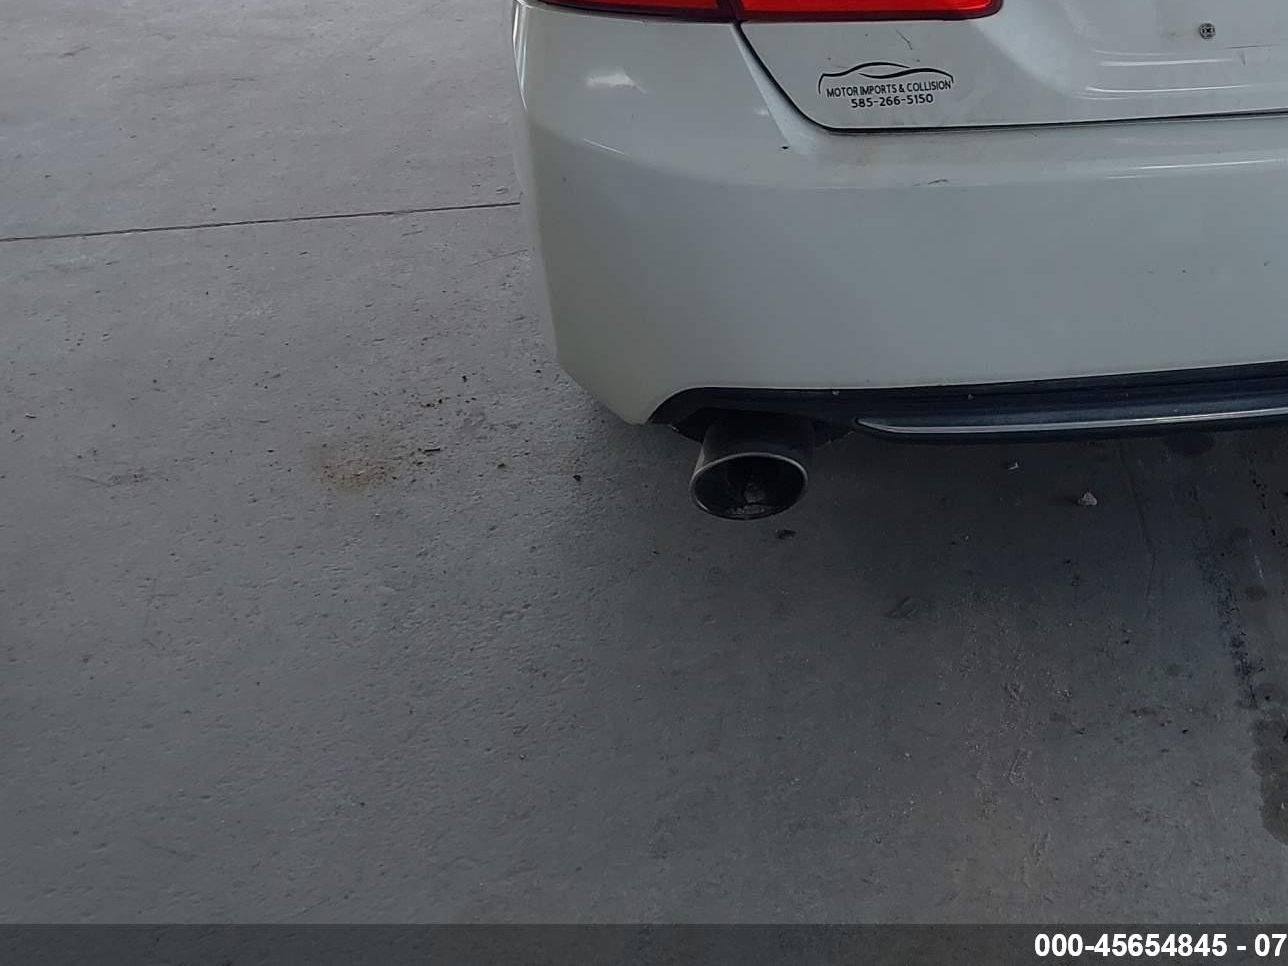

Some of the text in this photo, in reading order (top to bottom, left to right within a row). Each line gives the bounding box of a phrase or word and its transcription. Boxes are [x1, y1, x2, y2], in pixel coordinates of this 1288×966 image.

[826, 80, 952, 98] MOTOR IMPORTS & COLLISION
[851, 93, 934, 108] 585-266-5150
